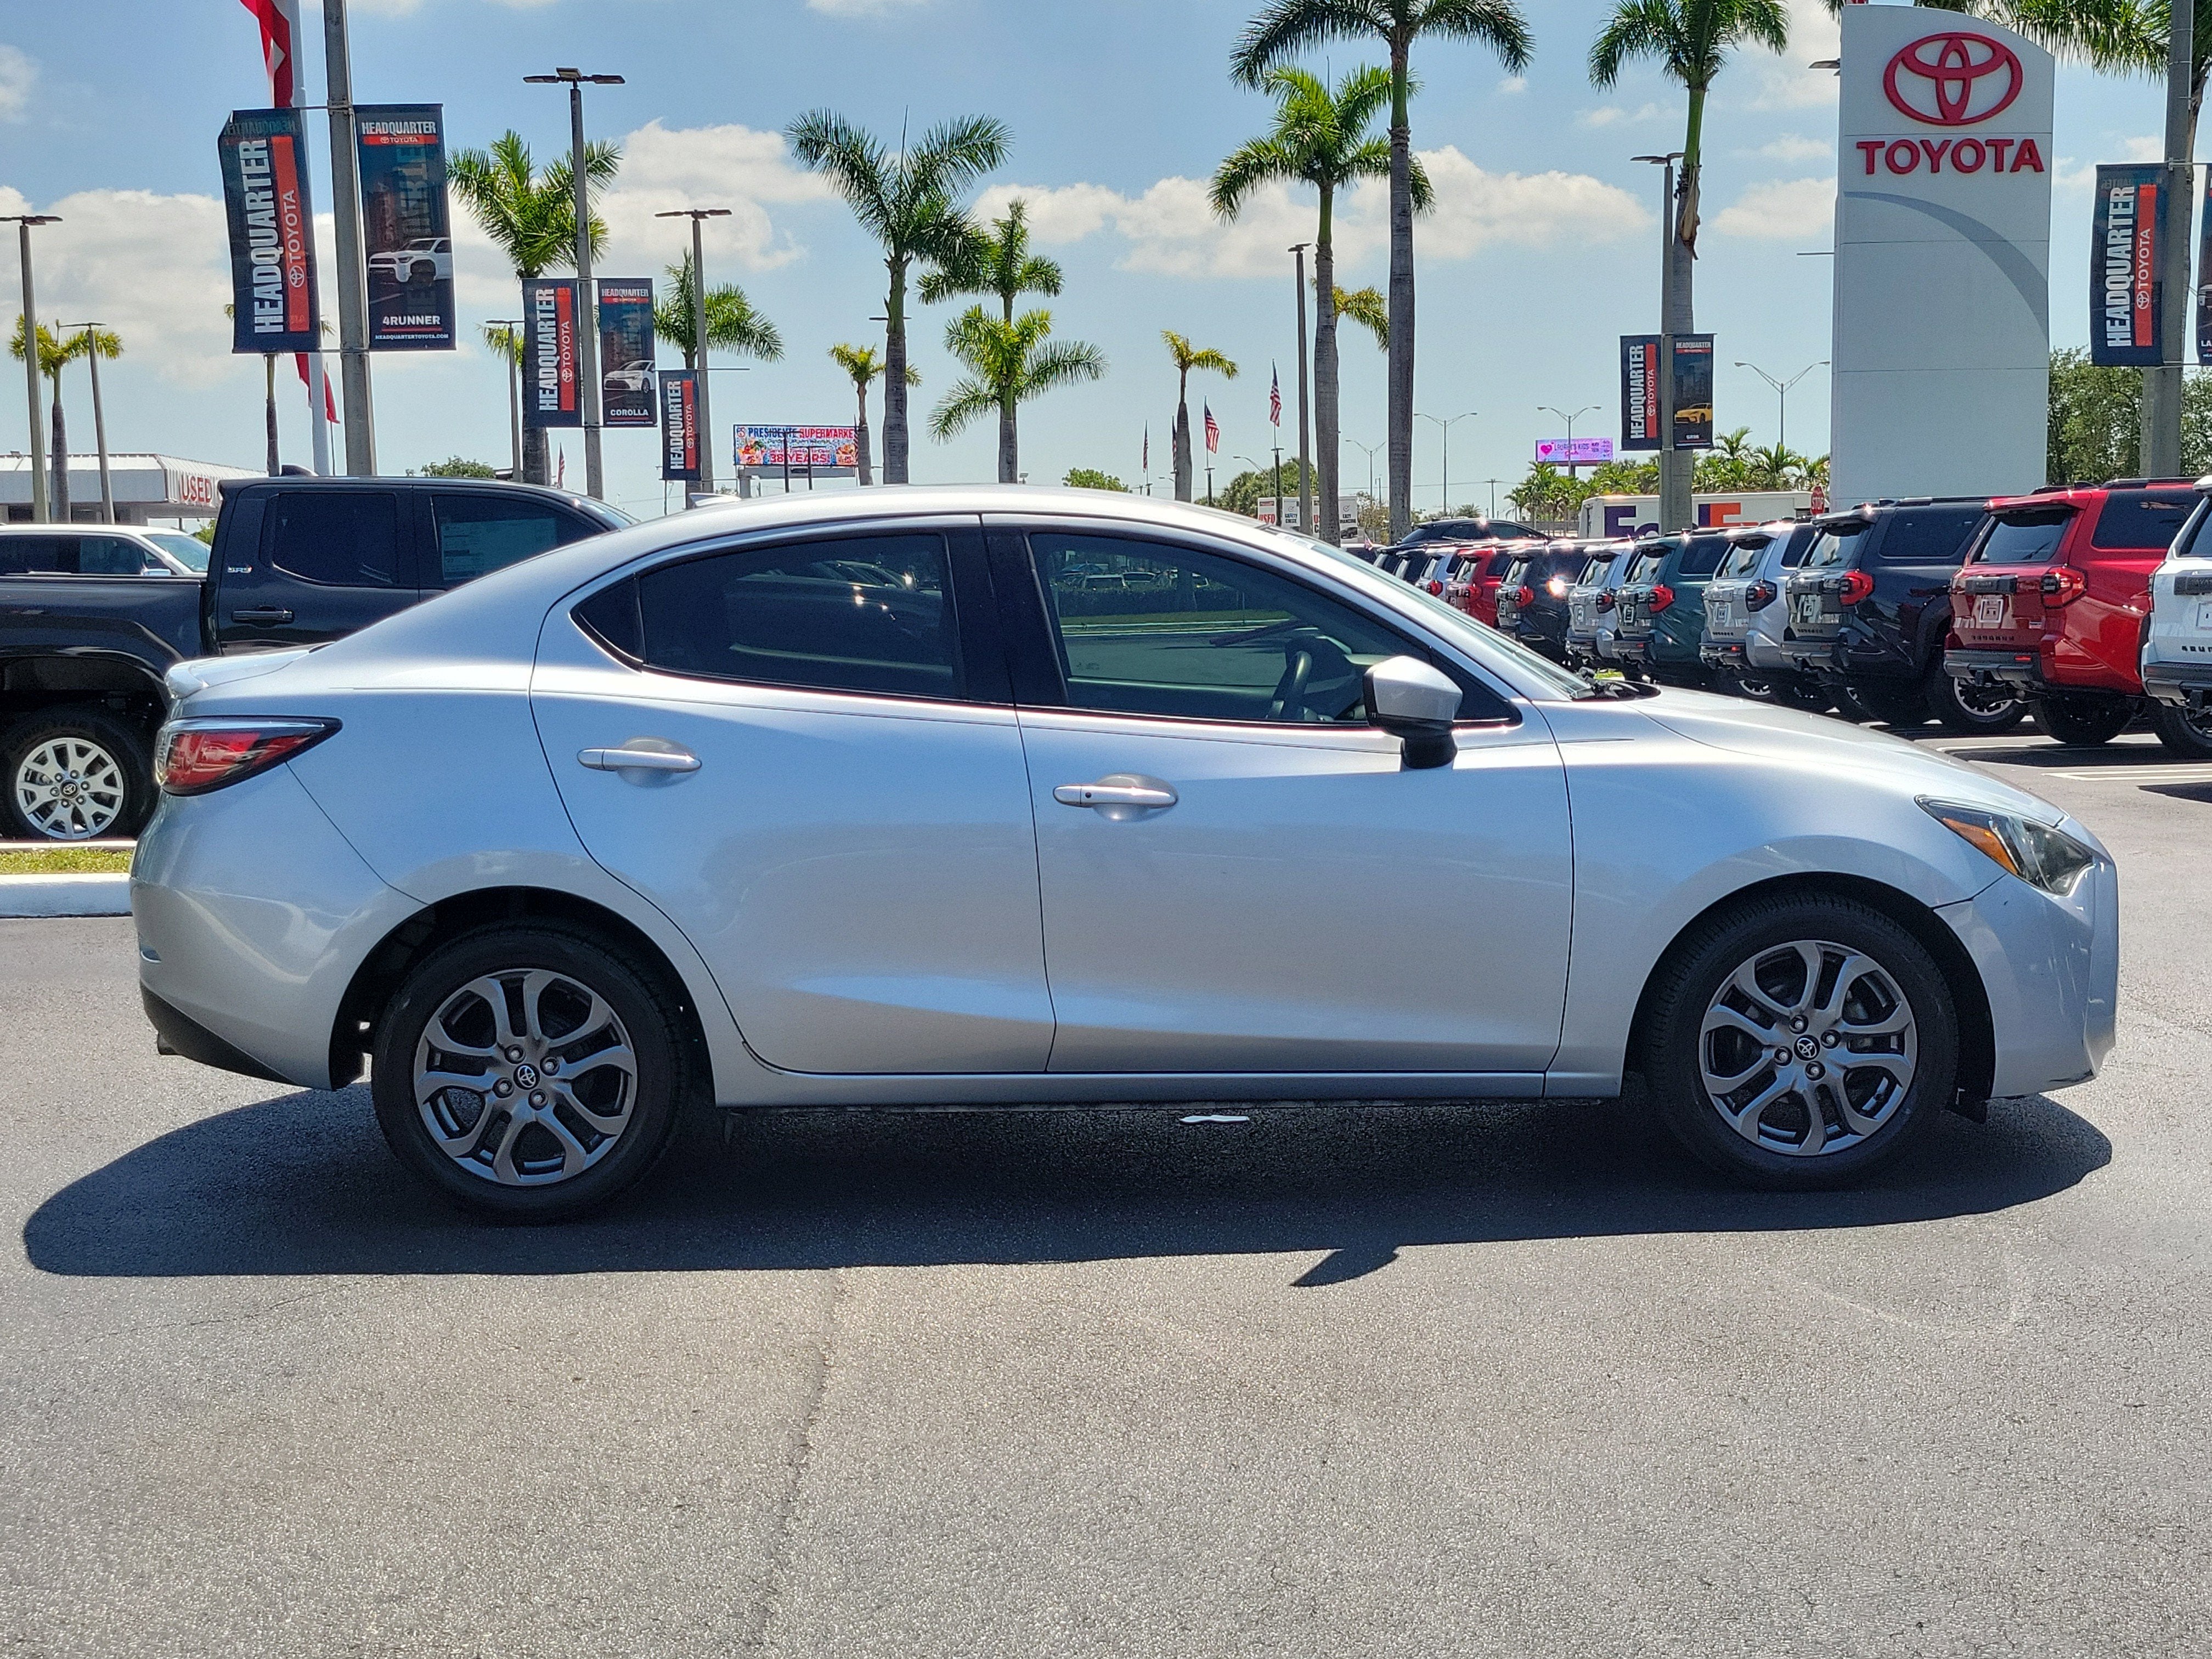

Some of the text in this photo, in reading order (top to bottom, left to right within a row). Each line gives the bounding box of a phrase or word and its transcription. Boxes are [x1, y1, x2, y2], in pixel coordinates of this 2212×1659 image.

[362, 121, 437, 136] HEADQUARTER
[1857, 138, 2045, 175] TOYOTA
[238, 137, 284, 334] HEADQUARTER
[283, 189, 302, 263] TOYOTA
[2106, 185, 2135, 347] HEADQUARTER
[2138, 228, 2151, 290] TOYOTA
[601, 288, 649, 298] HEADQUARTER
[382, 315, 441, 325] 4RUNNER
[535, 288, 560, 411] HEADQUARTER
[561, 320, 571, 367] TOYOTA
[1629, 345, 1646, 439] HEADQUARTER
[1647, 369, 1655, 404] TOYOTA
[667, 380, 685, 470] HEADQUARTER
[799, 428, 854, 438] SUPERMARKE
[770, 454, 784, 462] 38
[179, 474, 212, 503] USED
[1812, 496, 1824, 510] STOP
